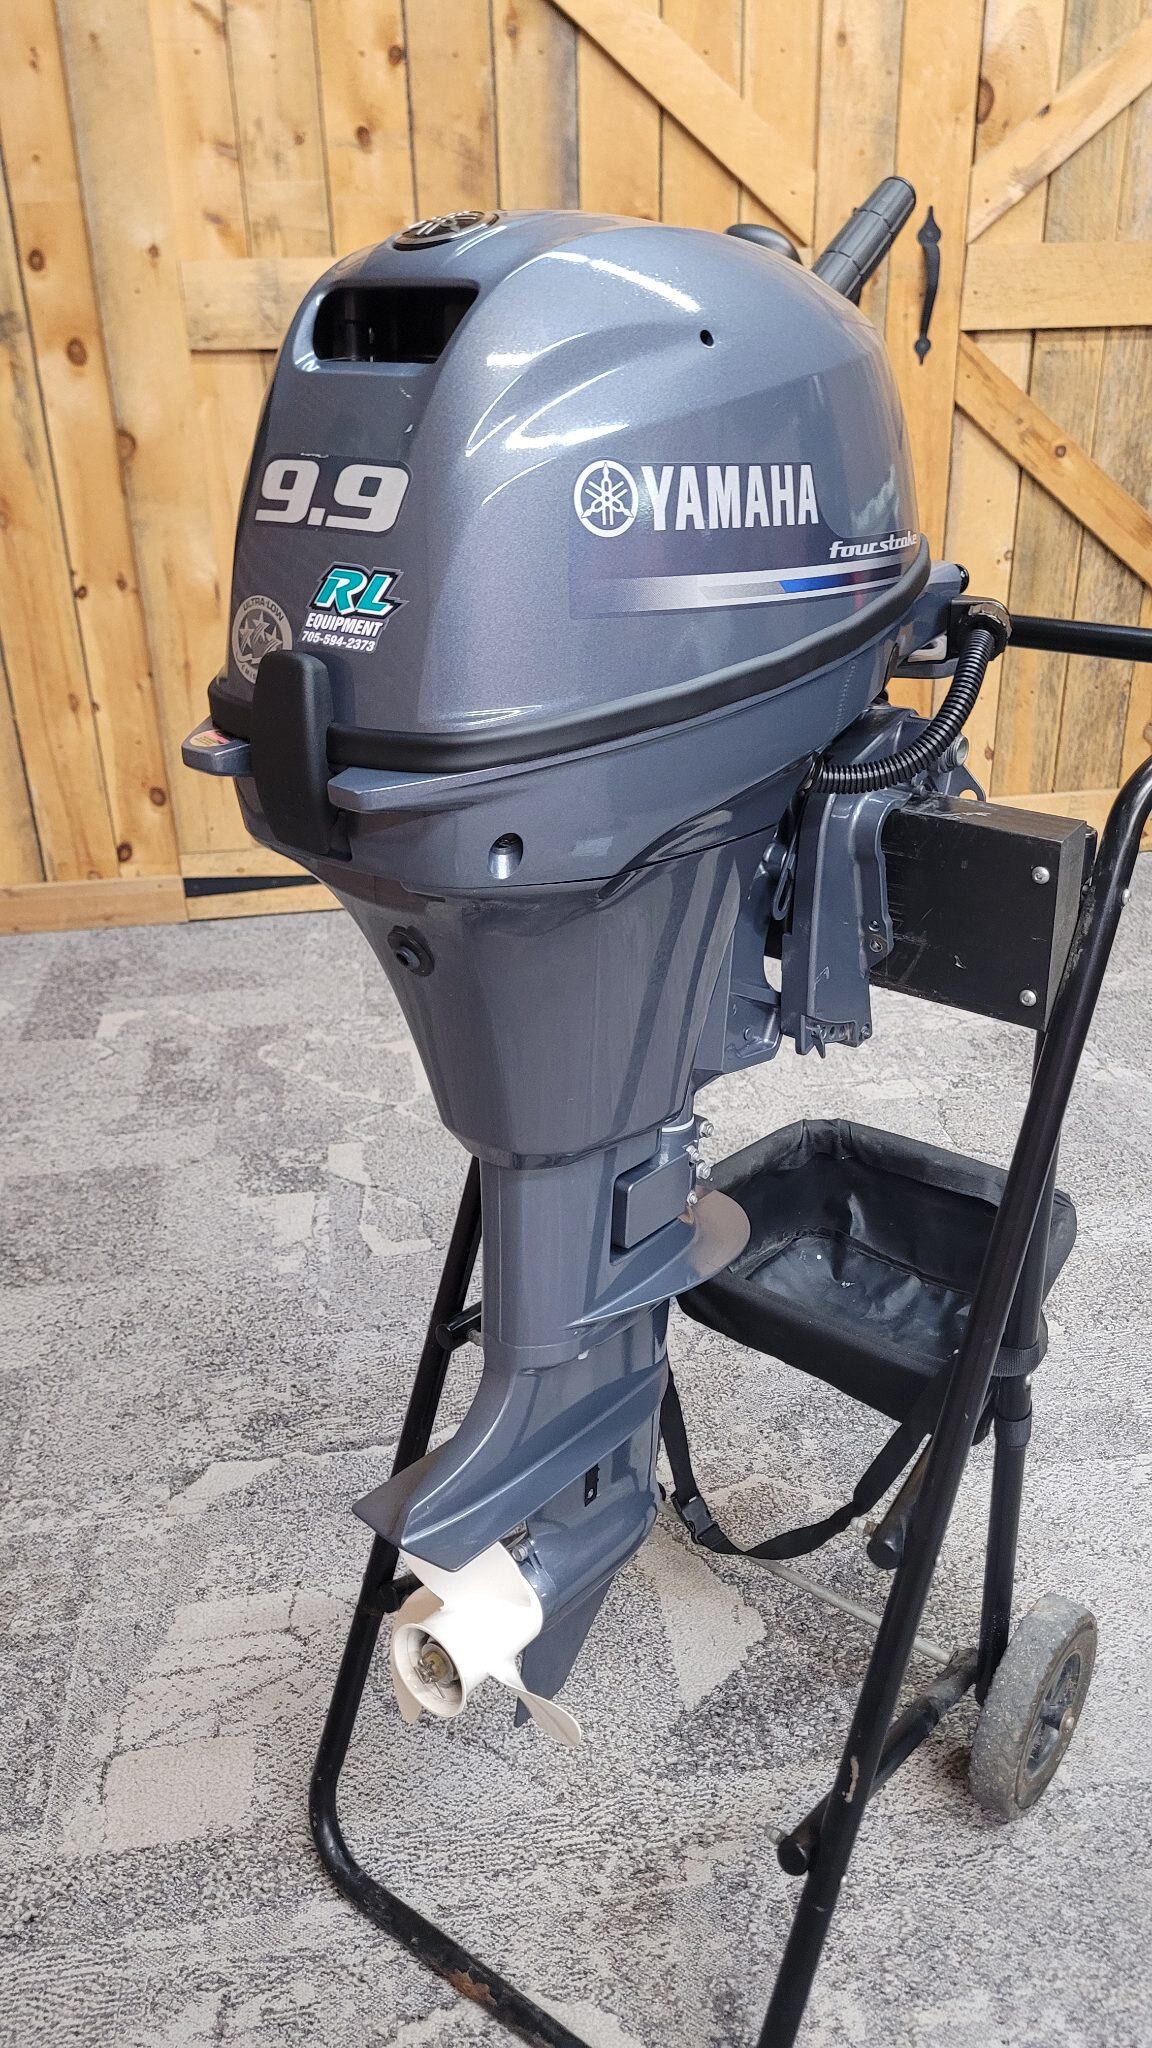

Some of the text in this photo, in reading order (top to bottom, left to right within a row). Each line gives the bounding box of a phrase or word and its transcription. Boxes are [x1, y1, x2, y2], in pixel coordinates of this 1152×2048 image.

[255, 458, 410, 533] 9.9
[642, 464, 819, 531] YAMAHA
[314, 567, 395, 616] RL
[301, 630, 376, 653] 705-594-2373
[305, 612, 384, 637] EQUIPMENT
